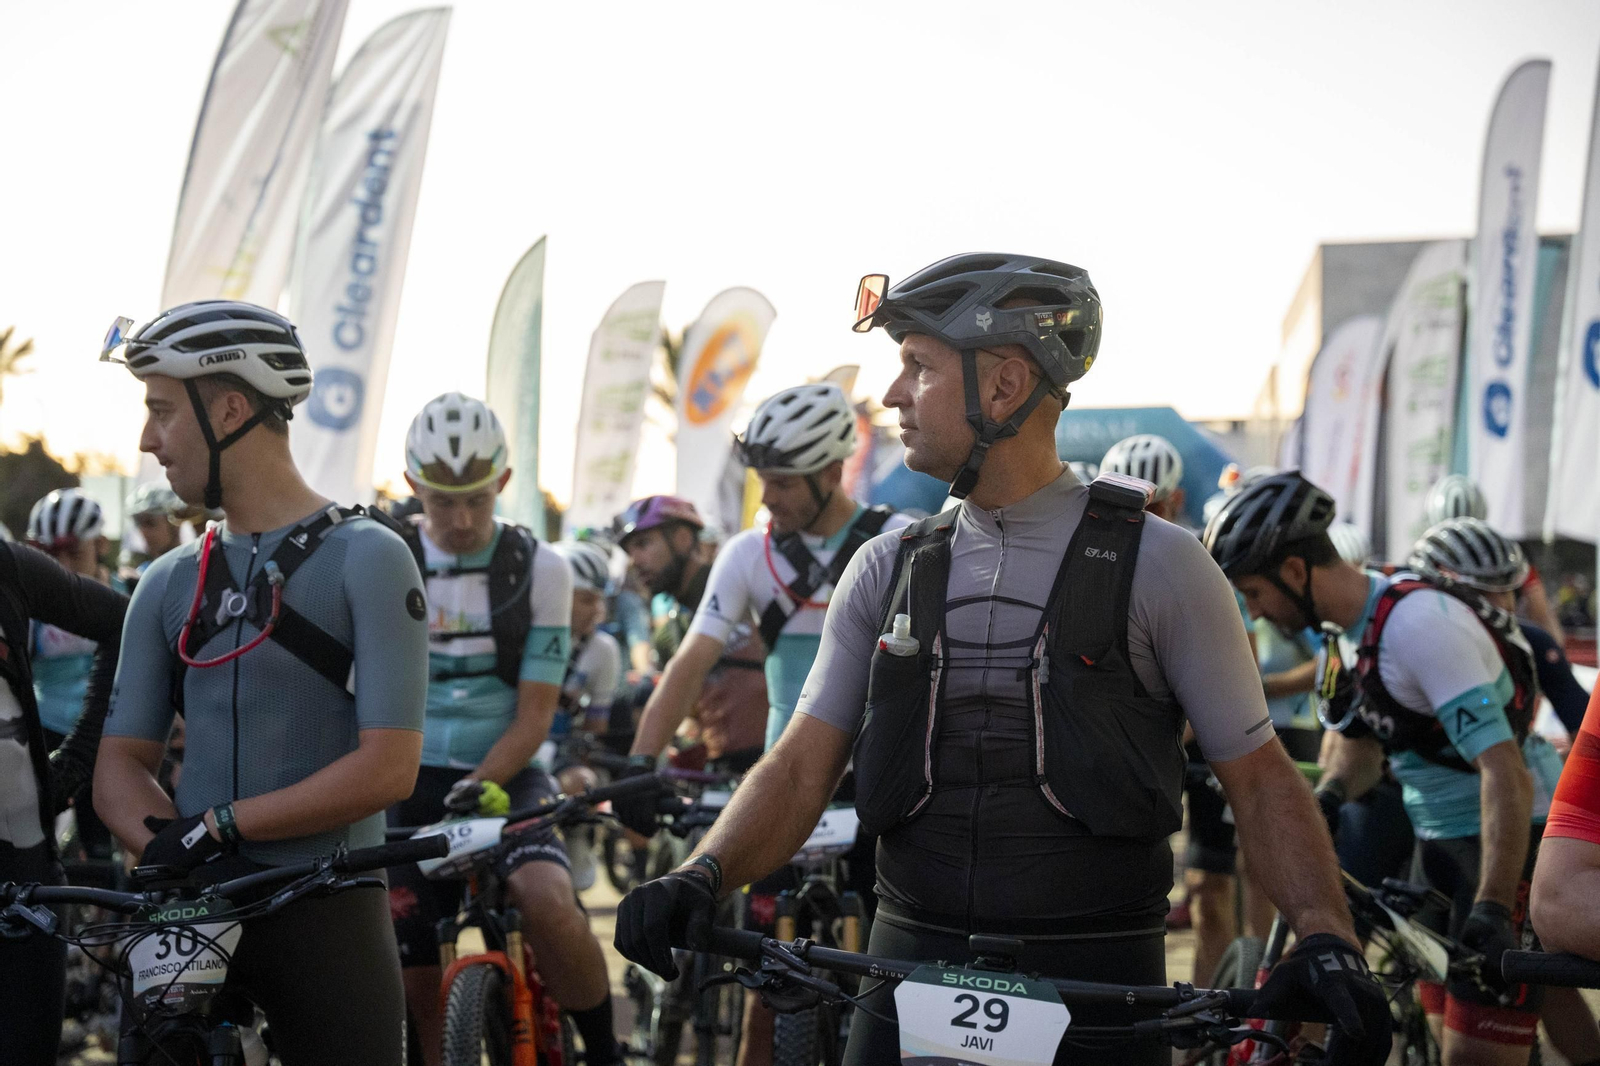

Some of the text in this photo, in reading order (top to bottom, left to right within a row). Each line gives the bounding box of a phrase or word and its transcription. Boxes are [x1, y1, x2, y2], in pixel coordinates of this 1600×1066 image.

[331, 128, 397, 351] Cleardent
[206, 350, 241, 365] ABUS
[155, 926, 198, 960] 30
[138, 961, 182, 982] FRANCISCO
[951, 993, 1010, 1033] 29
[960, 1035, 994, 1052] JAVI
